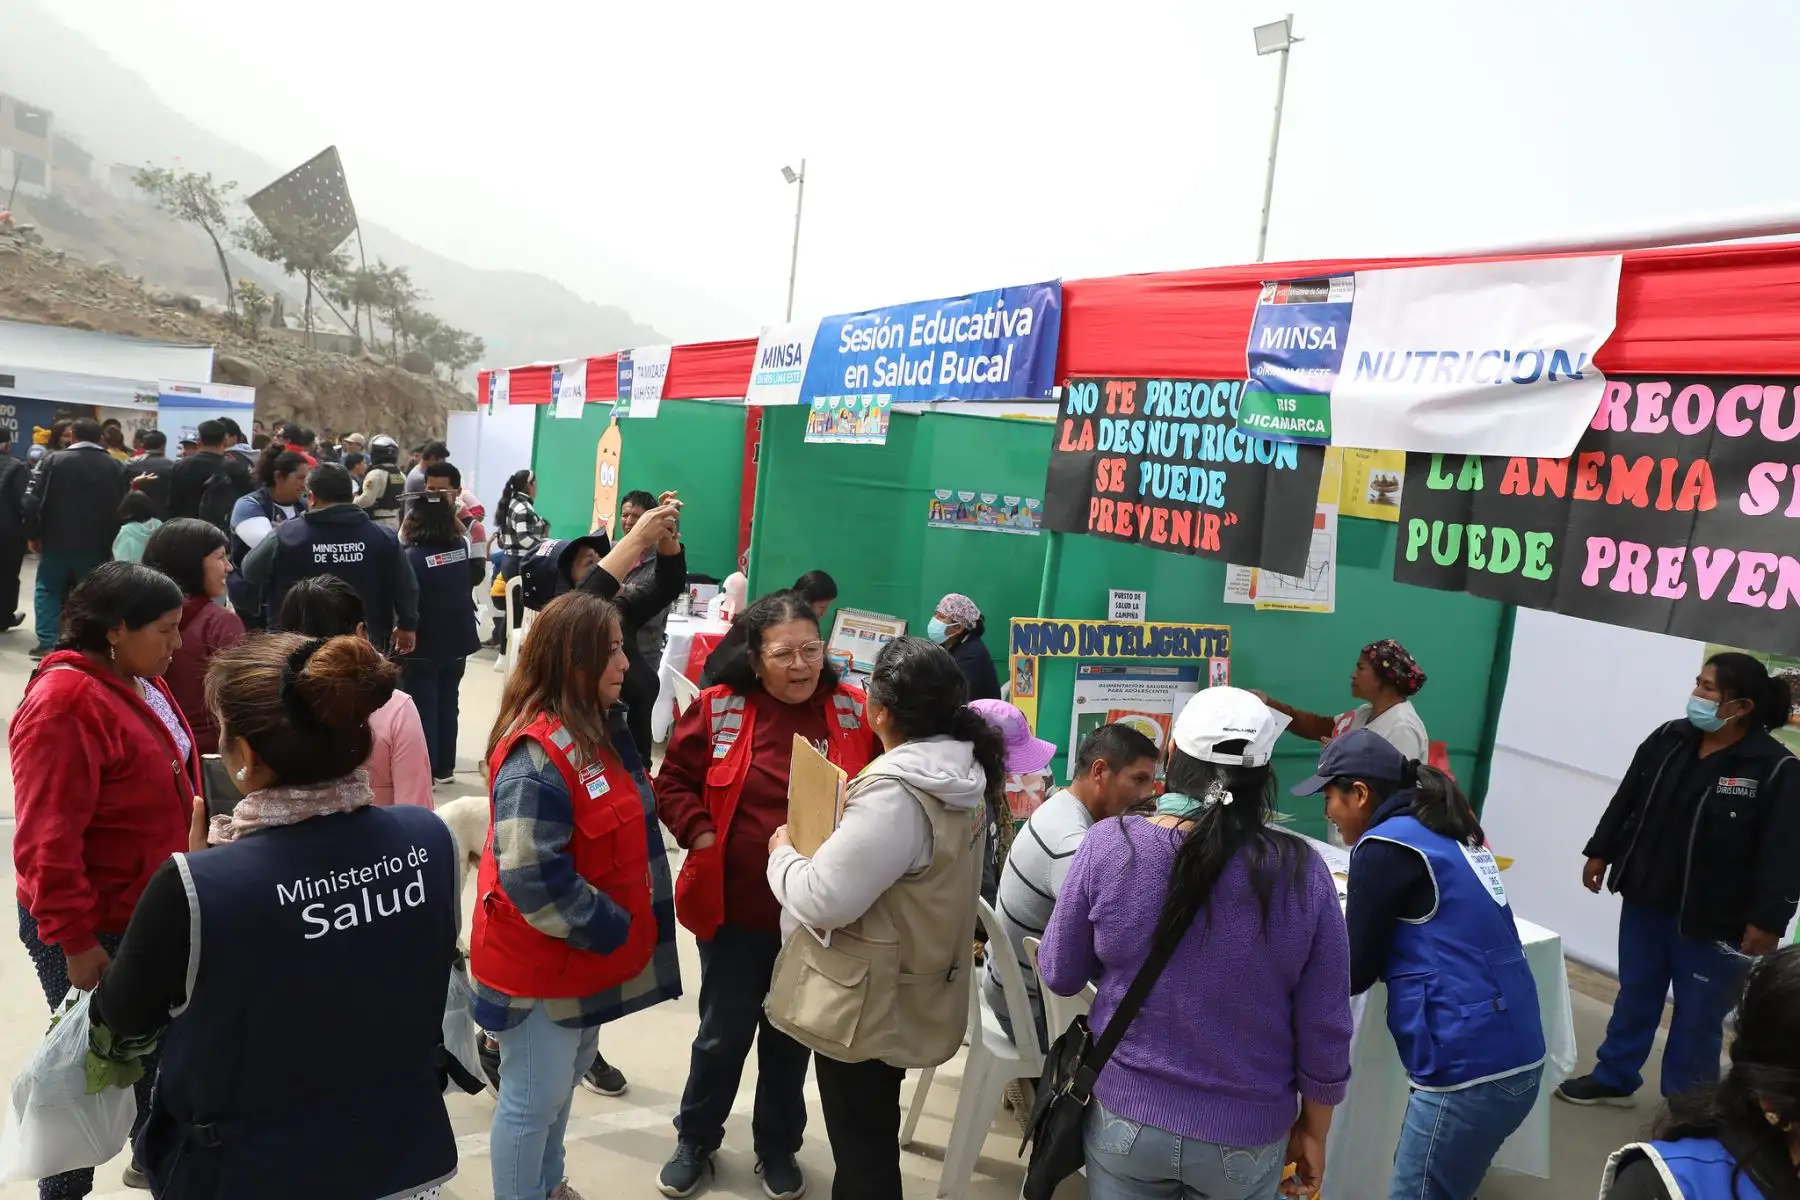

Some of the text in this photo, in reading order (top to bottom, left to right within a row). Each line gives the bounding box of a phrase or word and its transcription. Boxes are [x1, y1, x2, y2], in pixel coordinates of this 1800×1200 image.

[839, 300, 1034, 353] Sesión Educativa
[1259, 326, 1337, 350] MINSA
[760, 342, 802, 369] MINSA
[844, 344, 1013, 389] en Salud Bucal
[1105, 381, 1136, 414] TE
[1276, 398, 1297, 412] RIS
[1059, 418, 1095, 452] LA
[1243, 412, 1326, 433] JICAMARCA
[1096, 457, 1227, 509] SE PUEDE
[1426, 454, 1484, 491] LA
[1500, 452, 1718, 512] ANEMIA
[312, 541, 365, 553] MINISTERIO
[314, 552, 364, 563] DE SALUD
[1406, 518, 1554, 581] PUEDE
[1114, 591, 1133, 600] PUESTO
[276, 846, 428, 905] Ministerio de
[301, 870, 426, 939] Salud
